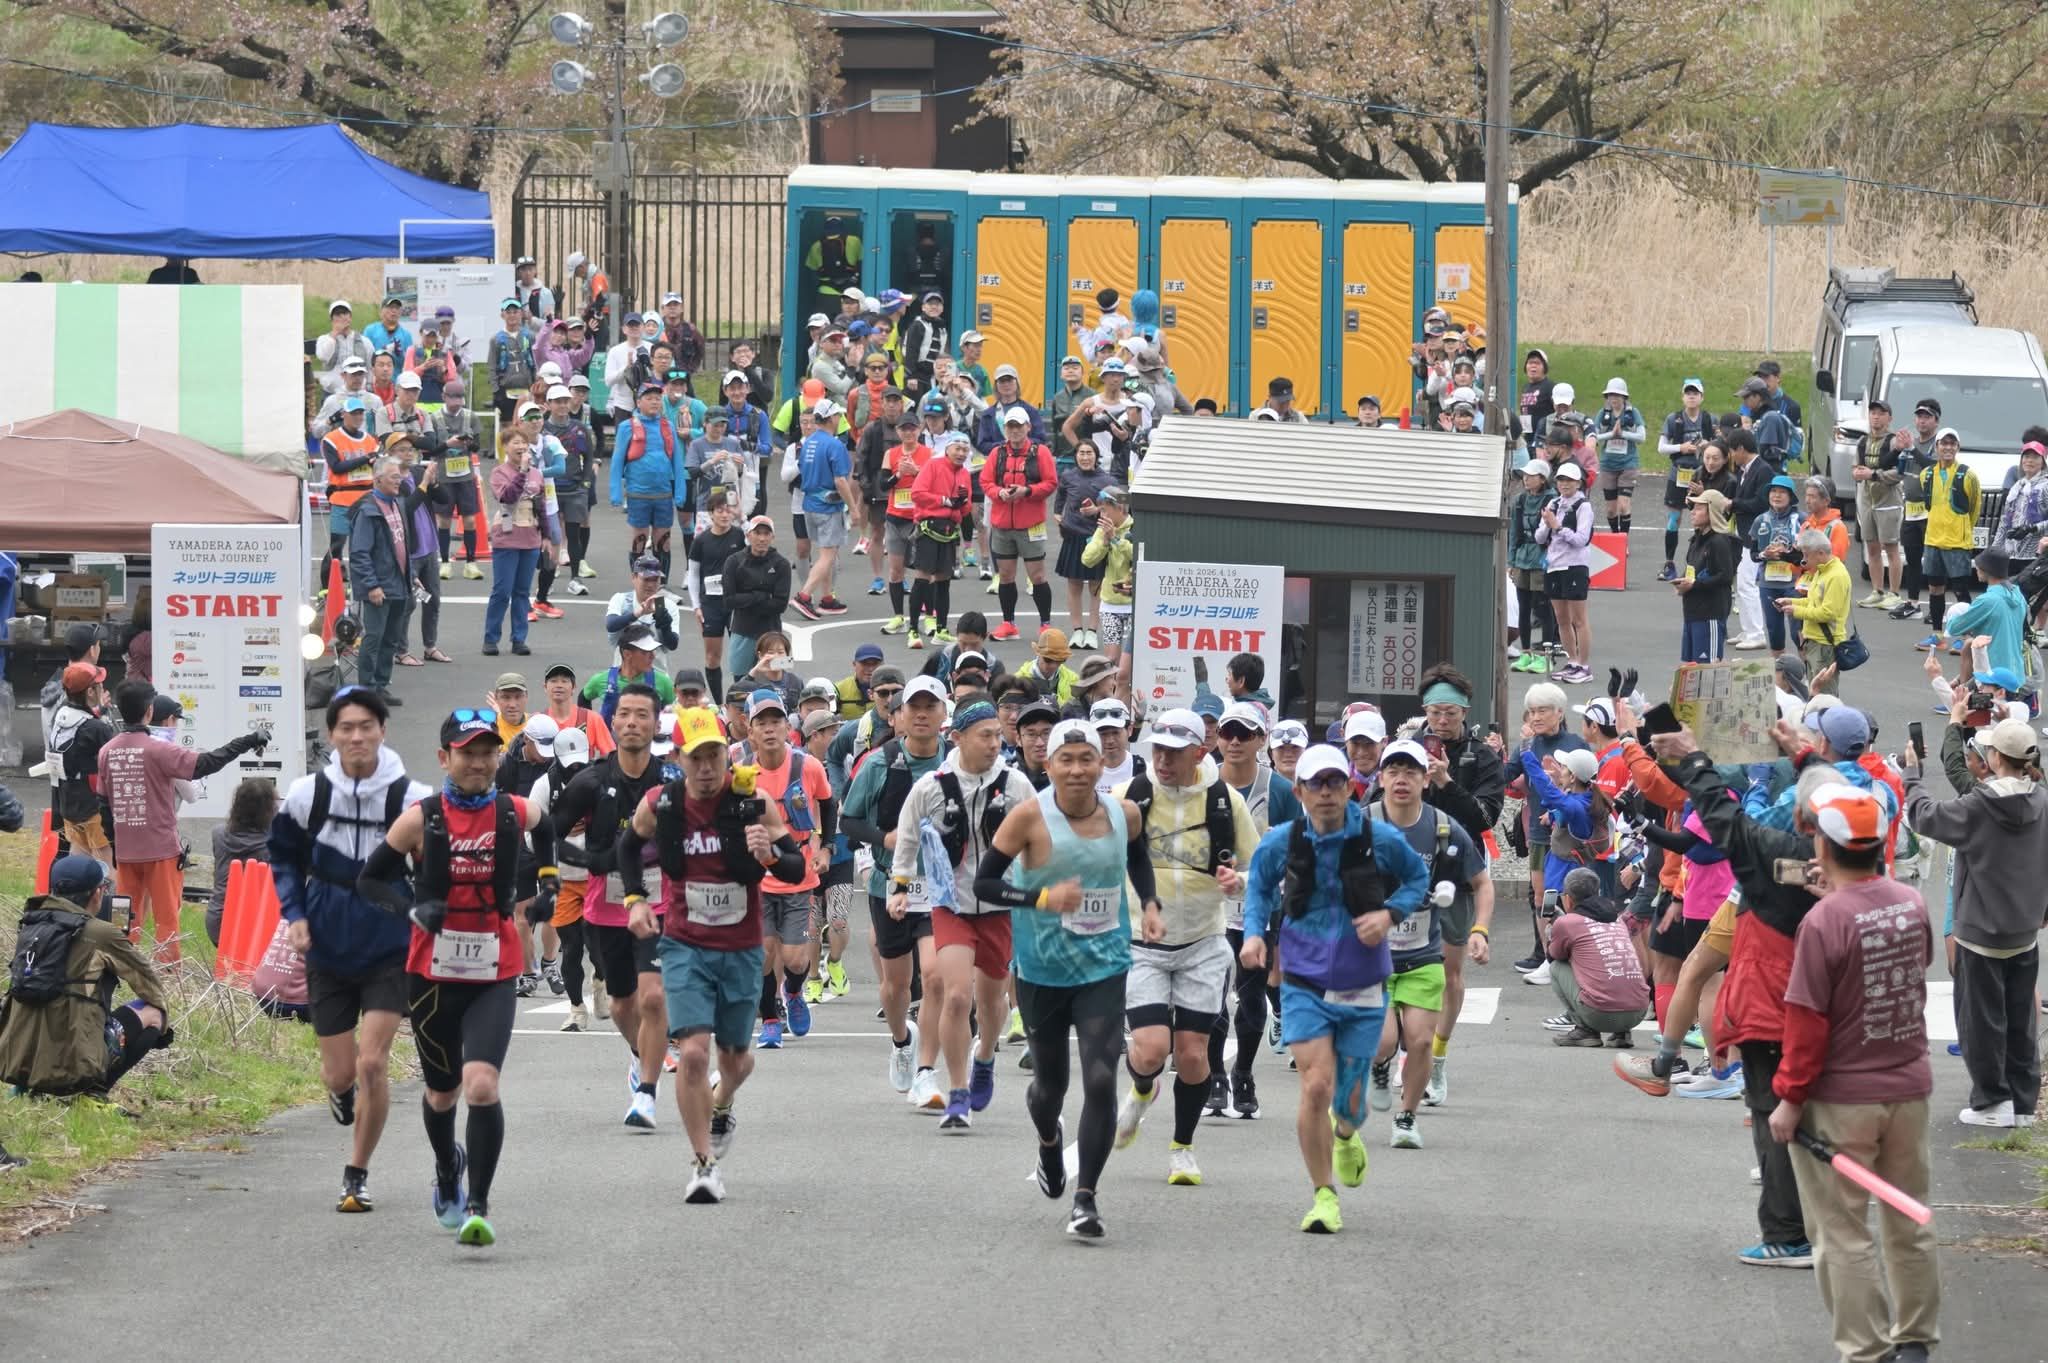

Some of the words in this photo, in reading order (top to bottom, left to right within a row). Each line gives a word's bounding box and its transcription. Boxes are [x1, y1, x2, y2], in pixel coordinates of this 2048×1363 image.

[980, 275, 999, 285] 洋式
[1072, 280, 1092, 290] 洋式
[1165, 281, 1184, 291] 洋式
[1254, 281, 1273, 291] 洋式
[1345, 285, 1366, 294] 洋式
[1437, 291, 1457, 300] 洋式
[168, 540, 232, 550] YAMADERA
[236, 541, 259, 551] ZAO
[264, 541, 283, 551] 100
[182, 553, 216, 562] ULTRA
[219, 554, 269, 563] JOURNEY
[173, 571, 277, 584] ネッツトヨタ山形
[1158, 576, 1229, 588] YAMADERA
[1234, 578, 1259, 589] ZAO
[1159, 587, 1198, 597] ULTRA
[1202, 588, 1258, 599] JOURNEY
[166, 594, 283, 617] START
[1154, 603, 1260, 620] ネッツトヨタ山形
[1148, 626, 1266, 653] START
[907, 883, 922, 894] 08
[705, 894, 730, 906] 104
[1084, 900, 1107, 913] 101
[455, 944, 482, 957] 117
